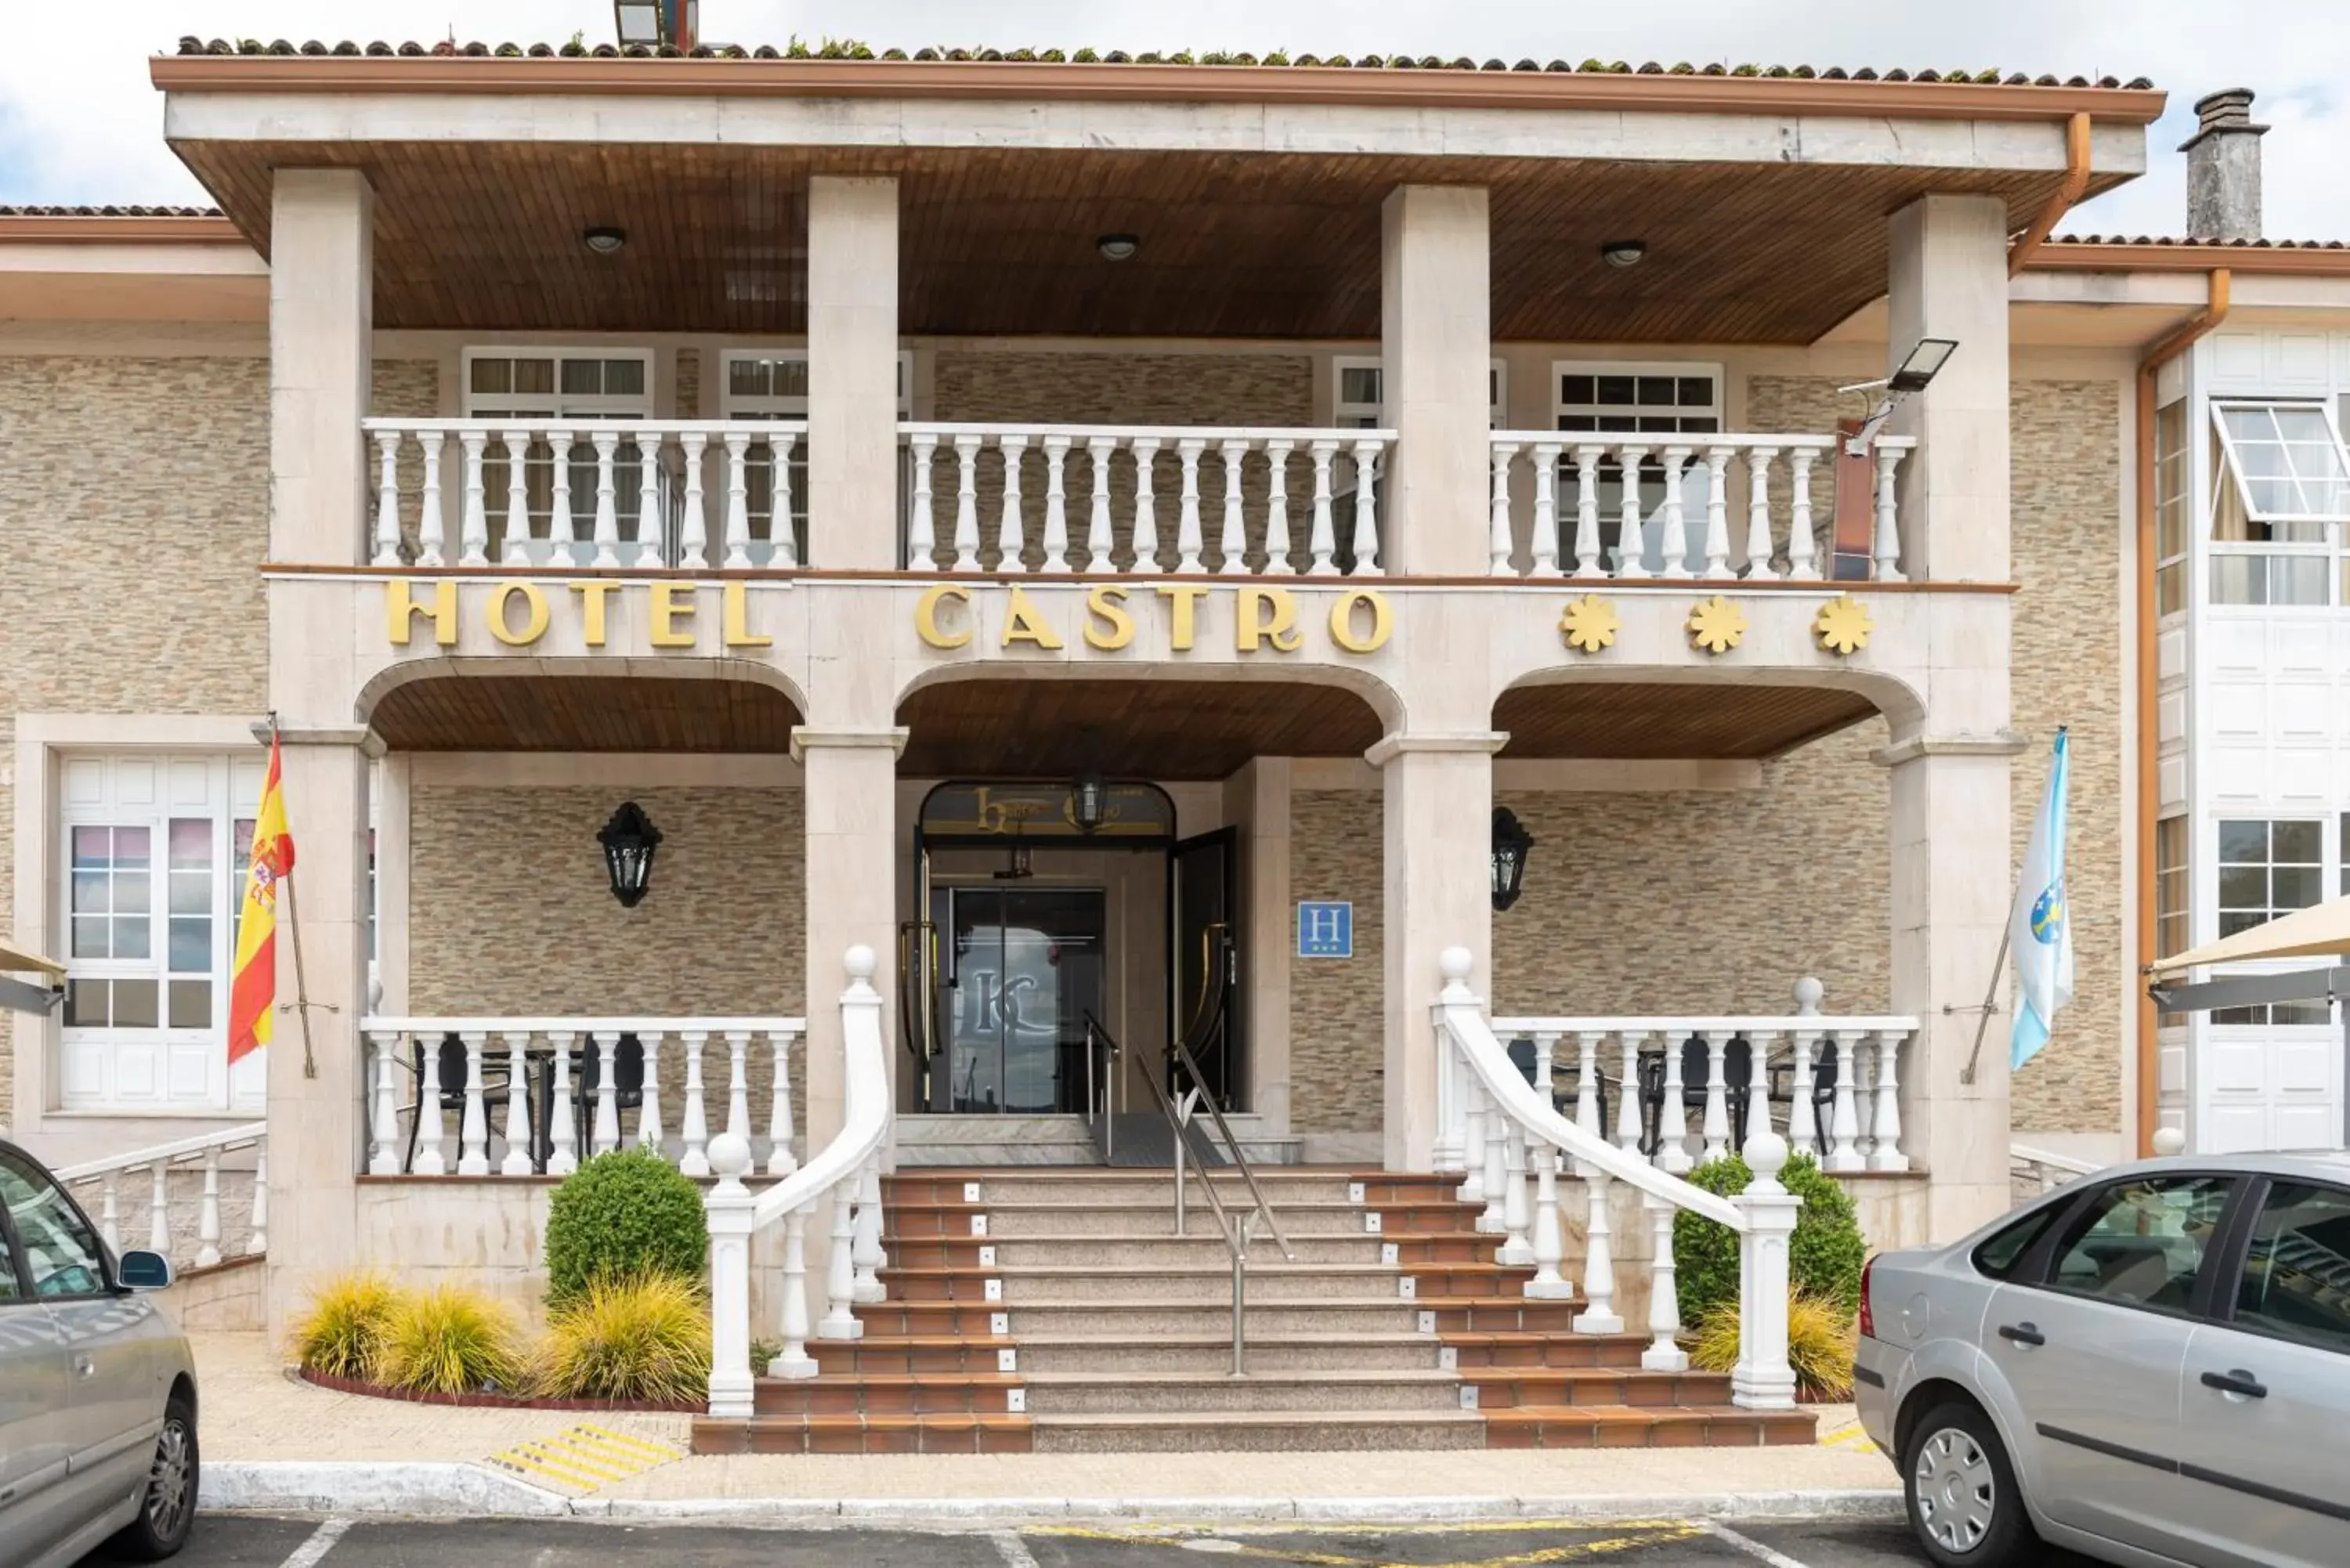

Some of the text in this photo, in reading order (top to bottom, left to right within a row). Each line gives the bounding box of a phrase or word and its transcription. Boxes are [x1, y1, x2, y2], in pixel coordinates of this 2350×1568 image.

[385, 580, 1393, 652] HOTEL CASTRO
[1309, 909, 1342, 943] H
